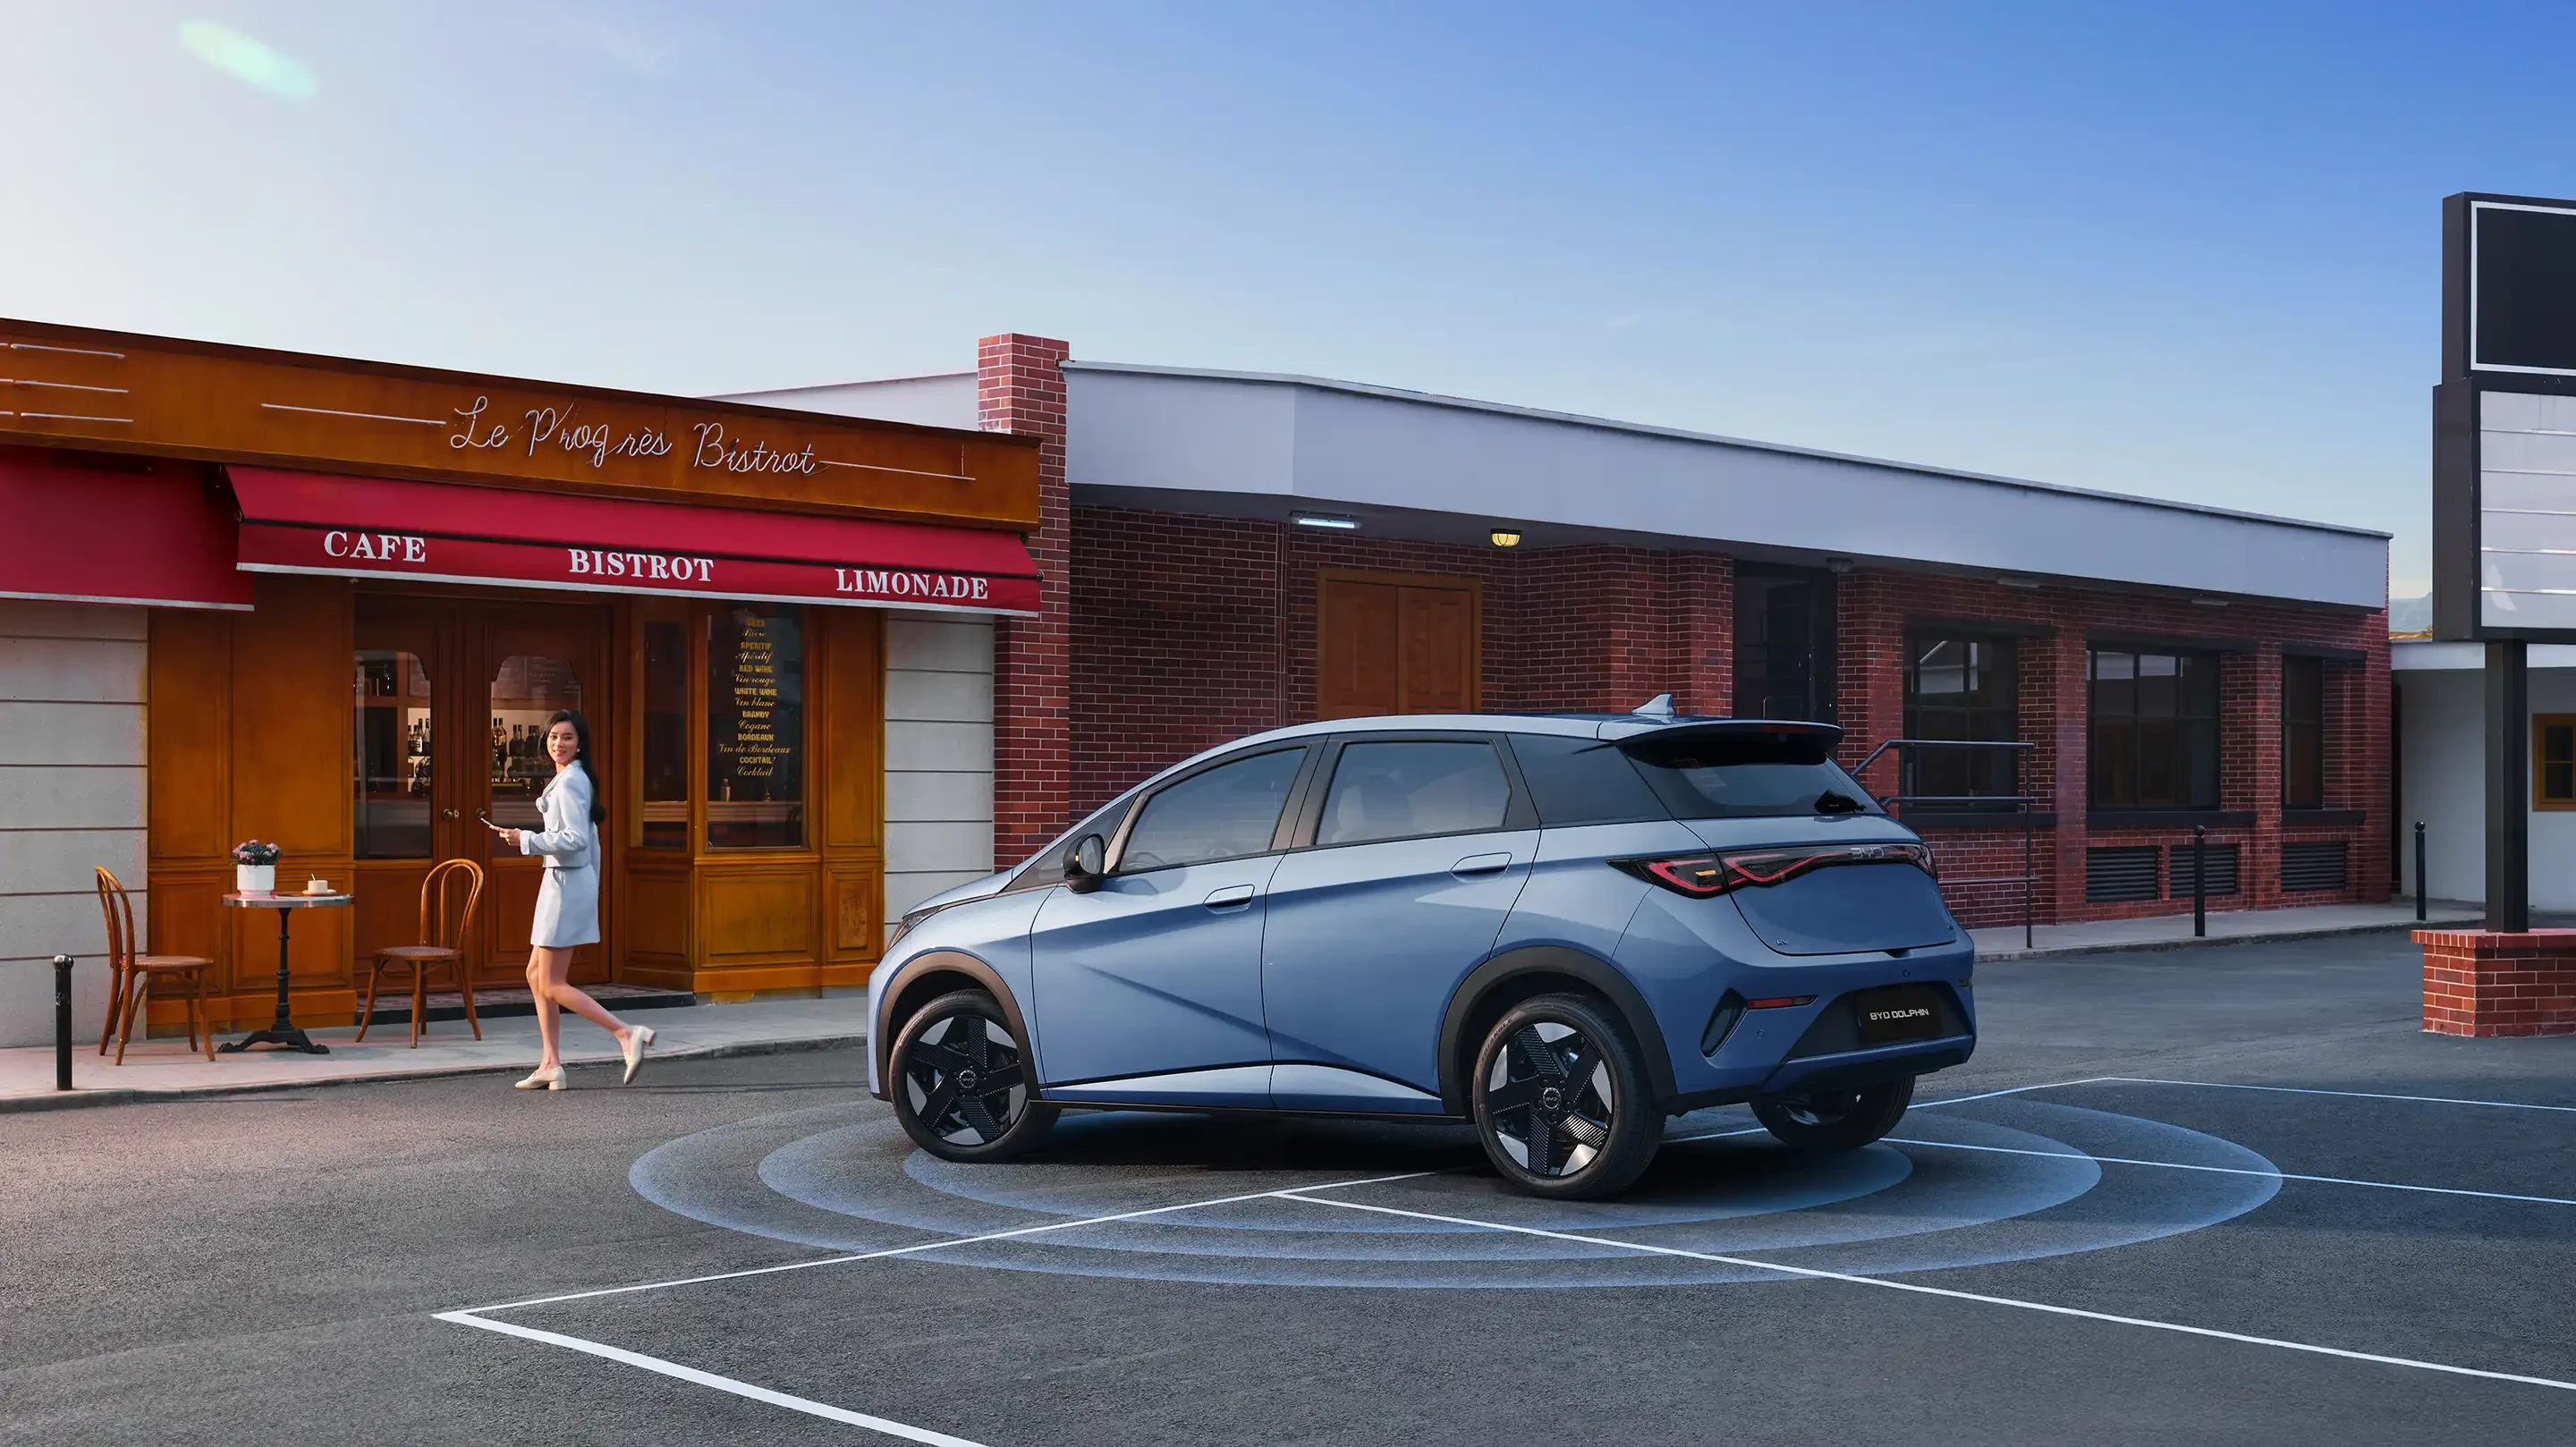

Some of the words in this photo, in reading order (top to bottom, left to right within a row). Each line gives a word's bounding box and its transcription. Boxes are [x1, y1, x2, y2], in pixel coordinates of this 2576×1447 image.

[450, 395, 508, 448] Le
[525, 407, 673, 468] Progrès
[693, 422, 816, 474] Bistrot
[324, 530, 426, 563] CAFE
[568, 548, 715, 582] BISTROT
[835, 568, 989, 600] LIMONADE
[755, 664, 773, 673] WINE
[734, 673, 749, 682] Vin
[751, 677, 775, 687] rouge
[734, 687, 758, 695] WHITE
[758, 688, 777, 696] WINE
[735, 698, 750, 707] Vin
[742, 710, 770, 718] BRANDY
[738, 733, 775, 741] BORDEAUX
[734, 742, 746, 753] de
[748, 743, 792, 754] Bordeaux
[739, 757, 773, 765] COCKTAIL
[736, 766, 774, 776] Cocktail
[1870, 1011, 1890, 1020] BYD
[1892, 1008, 1929, 1019] DOLPHIN
